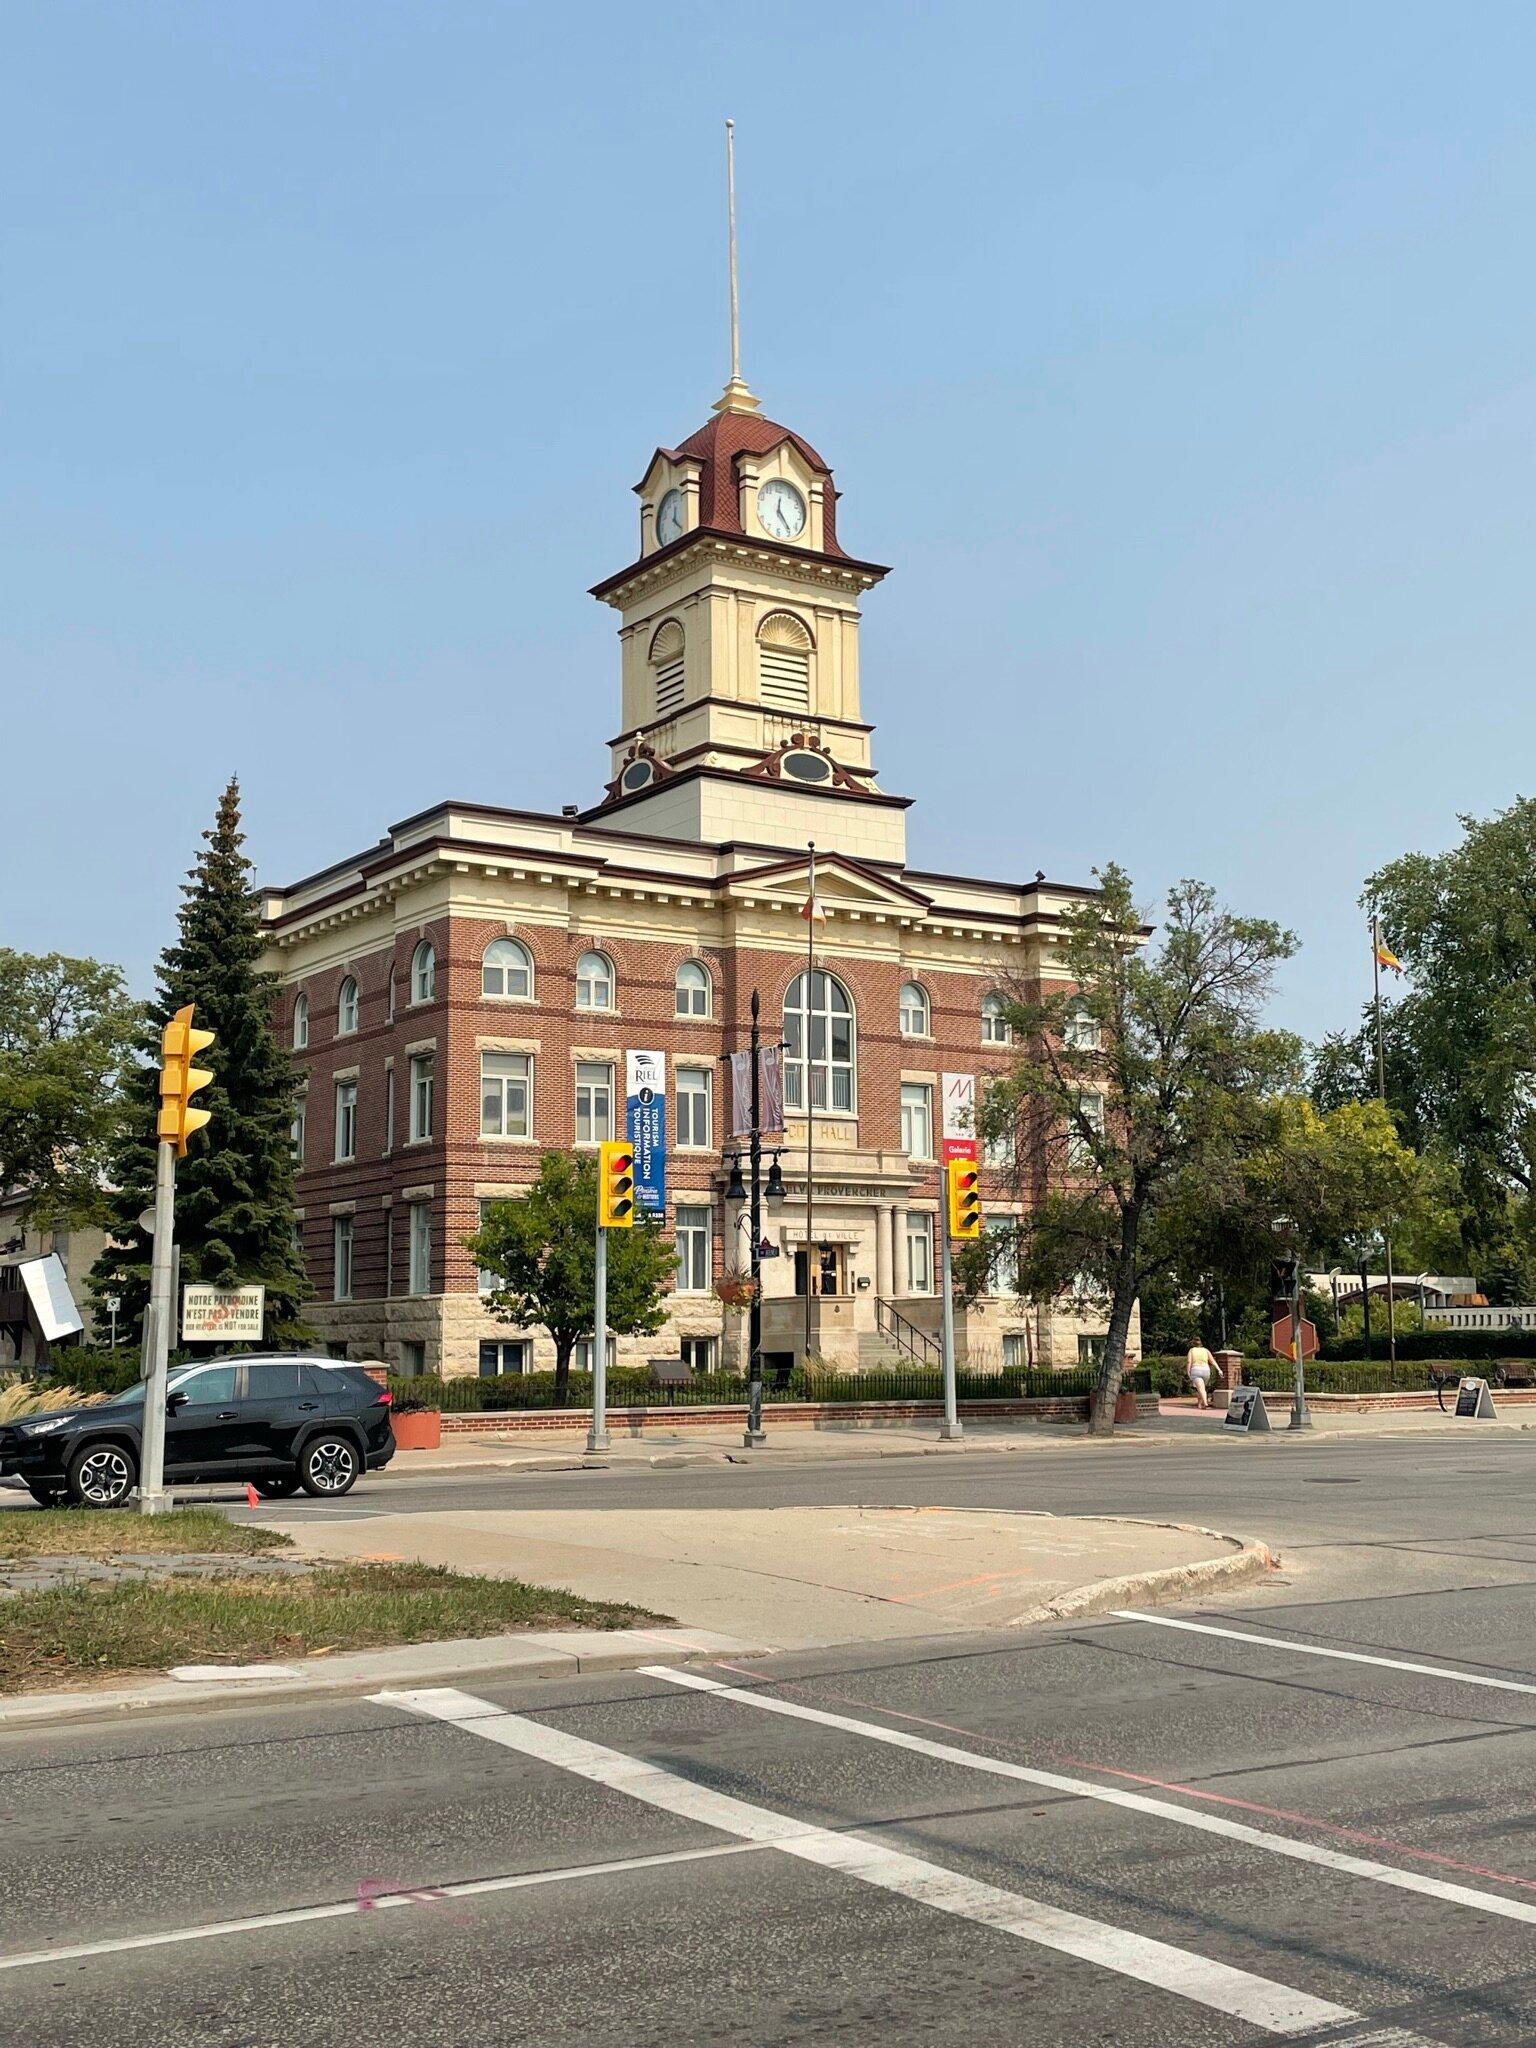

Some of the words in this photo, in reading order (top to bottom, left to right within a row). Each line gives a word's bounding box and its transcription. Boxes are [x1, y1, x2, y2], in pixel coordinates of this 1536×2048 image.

[636, 1069, 658, 1082] RIEL
[949, 1079, 972, 1098] M
[652, 1108, 660, 1147] TOURISM
[788, 1124, 808, 1138] CIT
[821, 1126, 852, 1141] HALL
[643, 1108, 651, 1180] INFORMATION
[948, 1145, 972, 1154] Galerie
[817, 1185, 887, 1198] PROVENCHER
[836, 1231, 859, 1240] VILLE
[188, 1295, 212, 1306] NOTRE
[186, 1309, 206, 1320] N'EST
[231, 1309, 259, 1320] VENDRE
[224, 1321, 237, 1331] NOT
